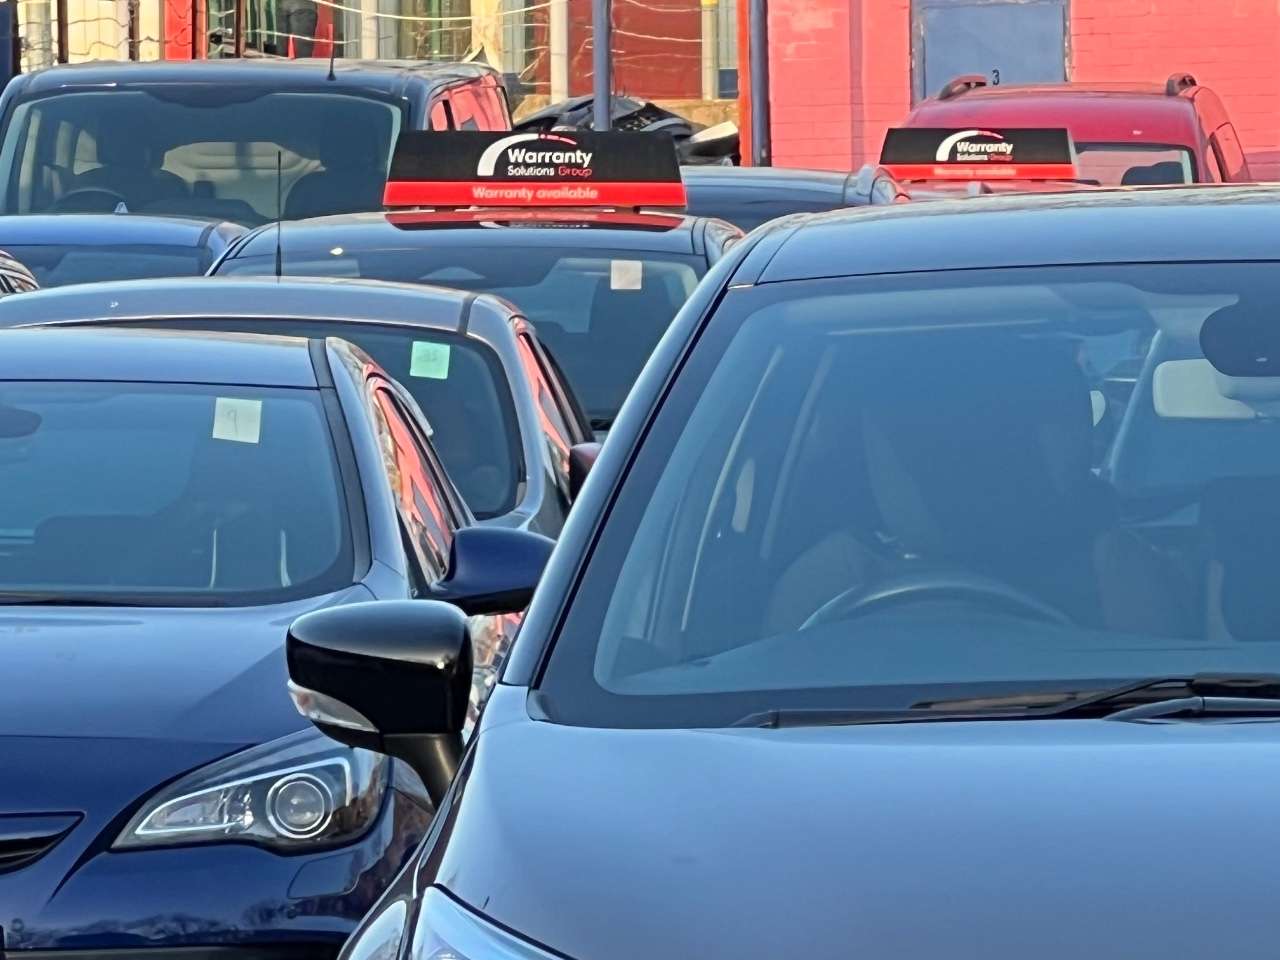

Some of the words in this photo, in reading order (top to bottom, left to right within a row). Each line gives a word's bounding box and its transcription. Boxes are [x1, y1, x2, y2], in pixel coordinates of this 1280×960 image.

[992, 69, 1000, 86] 3
[956, 141, 1014, 154] Warranty
[507, 148, 593, 168] Warranty
[507, 165, 555, 176] Solutions
[558, 166, 593, 178] Group
[472, 186, 535, 202] Warranty
[536, 186, 599, 199] available
